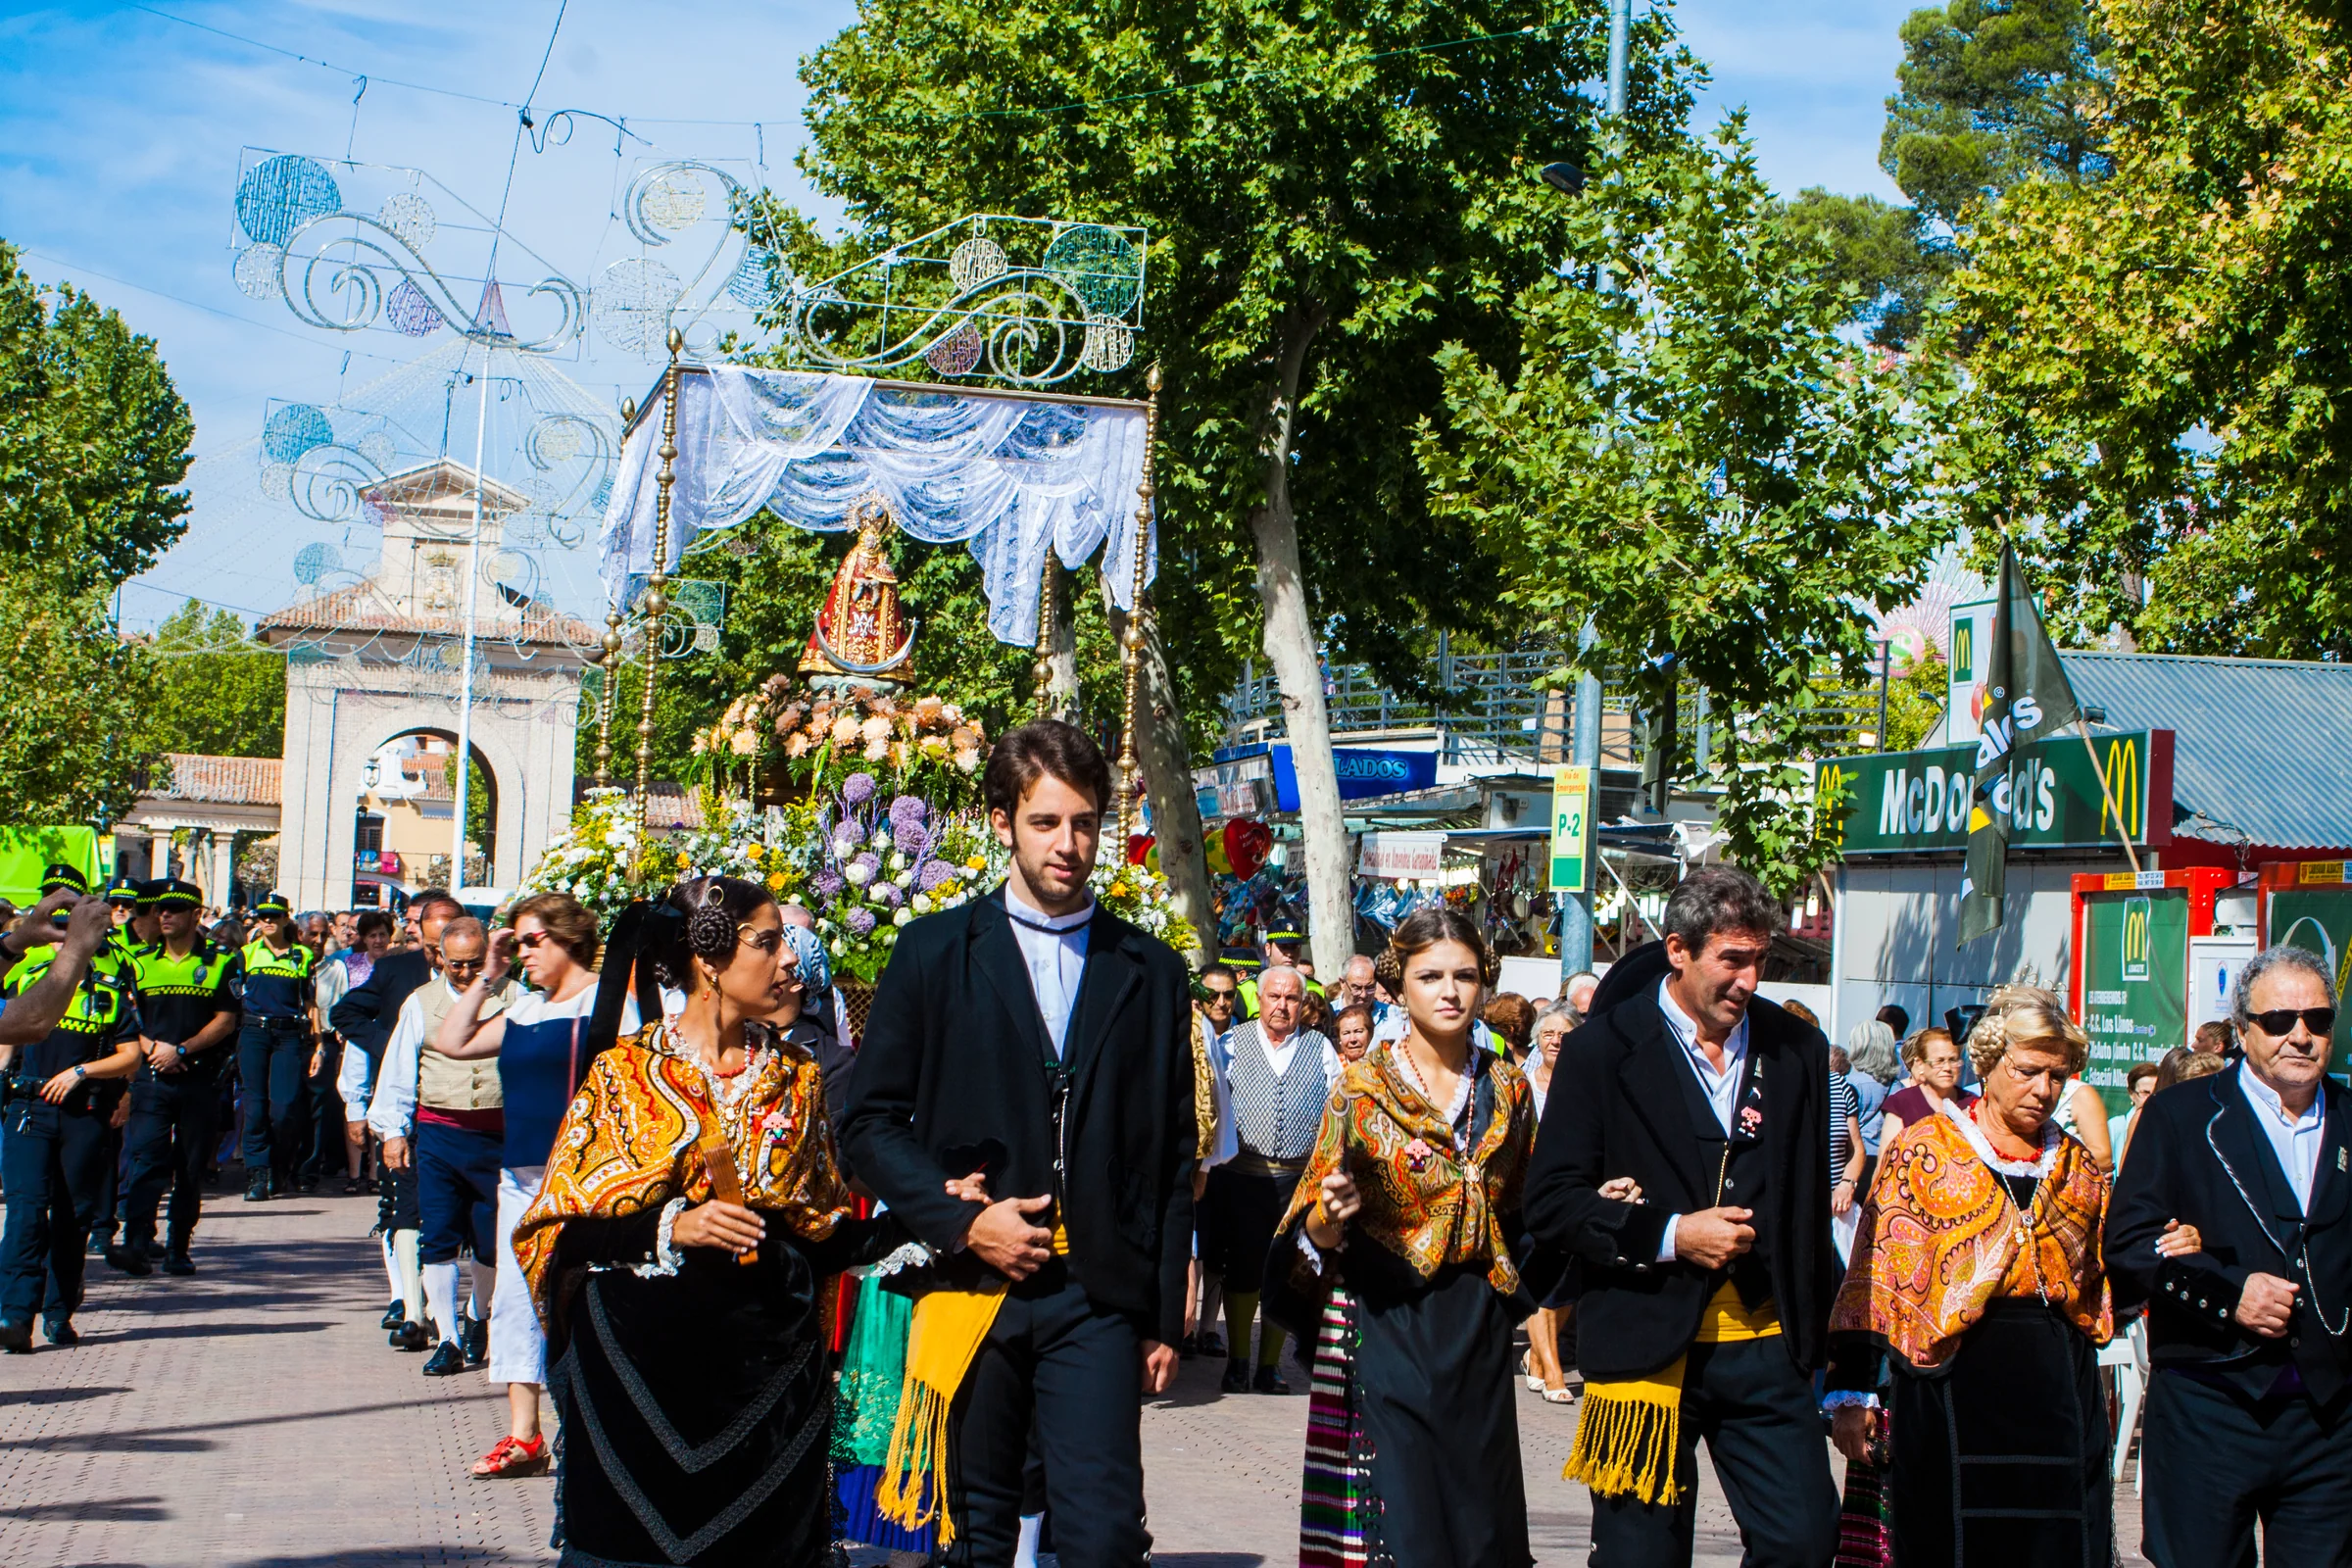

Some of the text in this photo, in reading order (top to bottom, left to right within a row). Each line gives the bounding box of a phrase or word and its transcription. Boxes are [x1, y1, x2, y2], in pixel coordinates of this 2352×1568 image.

[1556, 783, 1586, 793] Emergencia
[1880, 758, 2056, 835] McDod's
[1558, 813, 1580, 837] P-2
